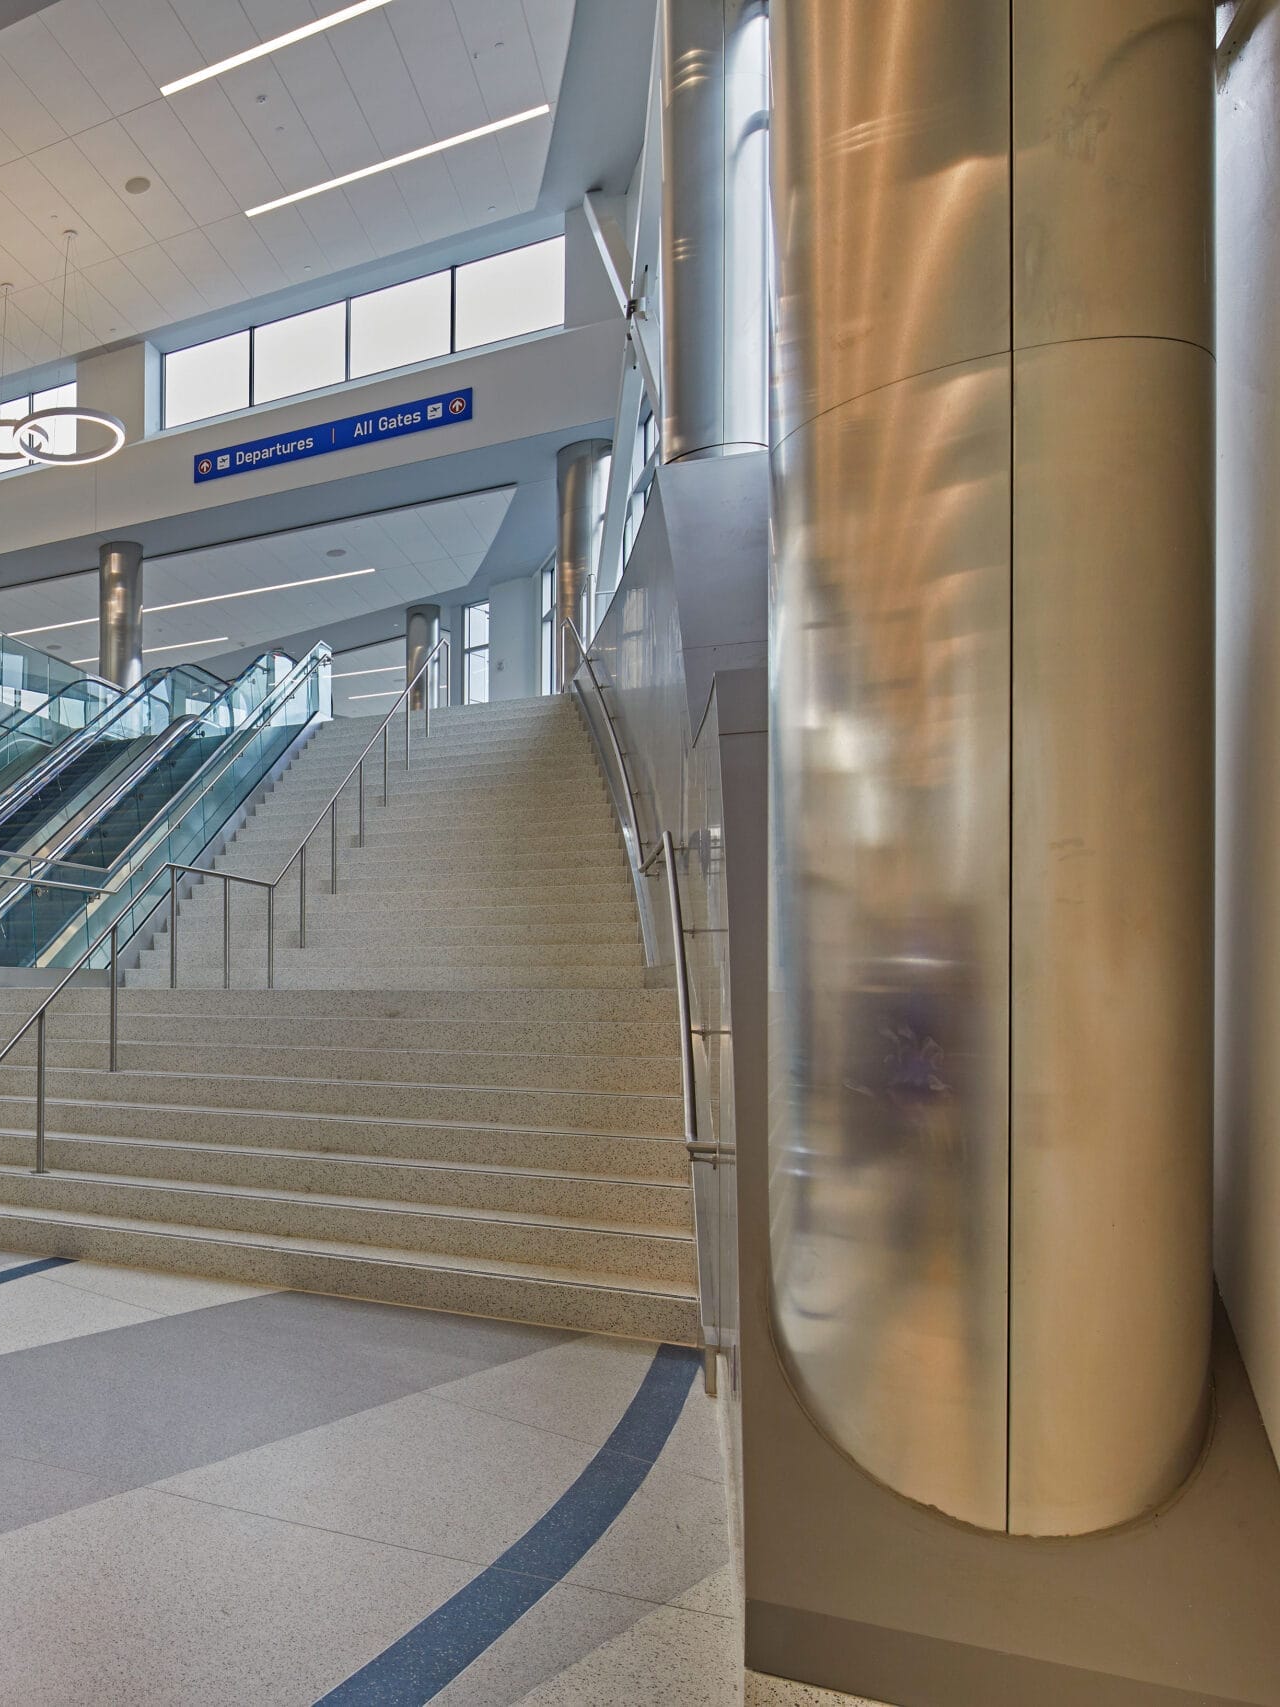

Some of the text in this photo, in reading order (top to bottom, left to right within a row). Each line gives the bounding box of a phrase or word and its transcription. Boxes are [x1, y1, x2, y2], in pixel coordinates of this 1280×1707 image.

[353, 411, 421, 438] All Gates
[236, 437, 314, 465] Departures
